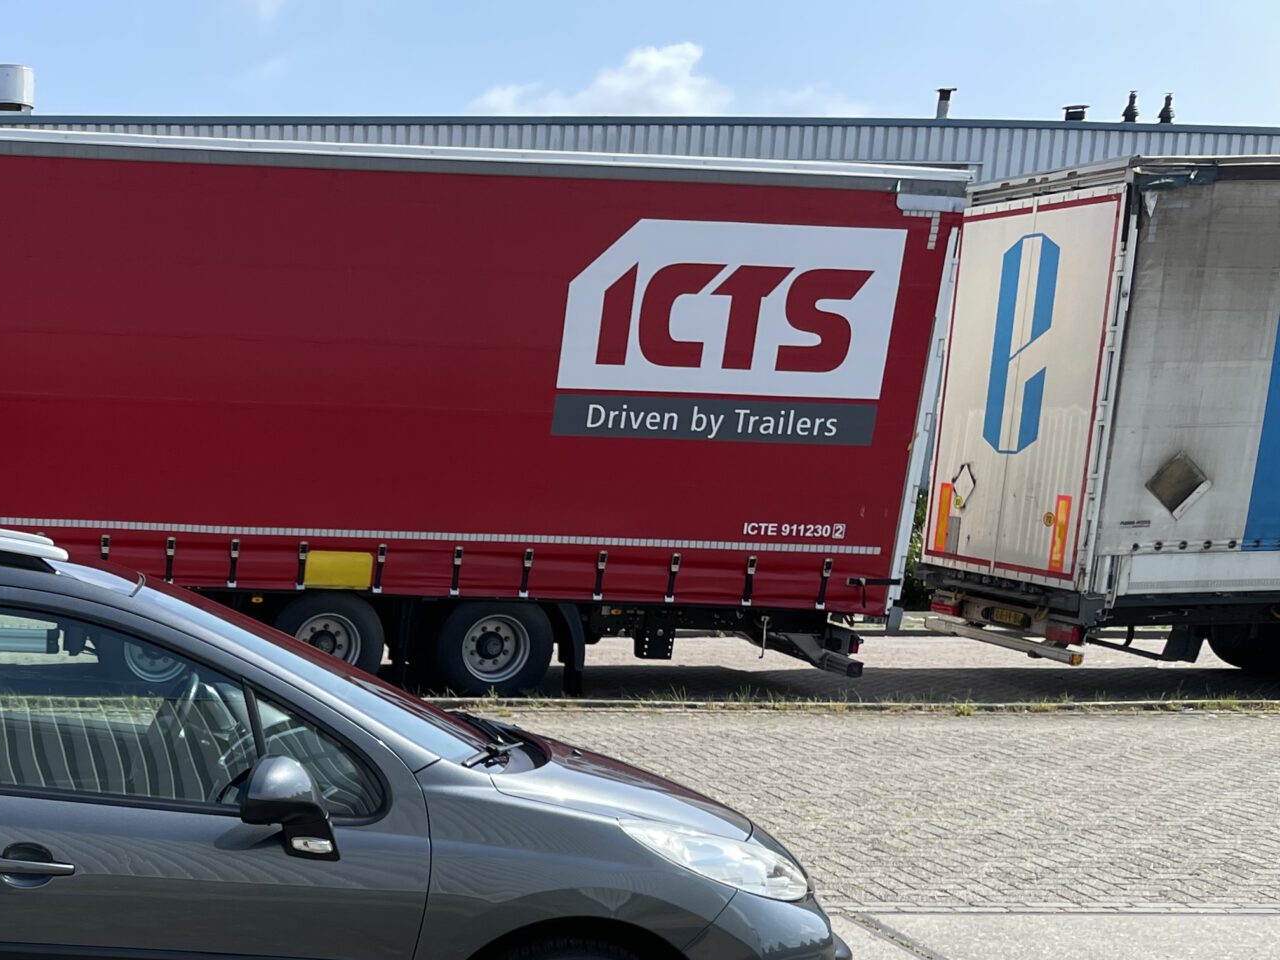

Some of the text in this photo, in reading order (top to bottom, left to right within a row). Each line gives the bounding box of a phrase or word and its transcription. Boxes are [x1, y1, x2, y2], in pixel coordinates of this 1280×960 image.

[595, 262, 875, 373] ICTS
[585, 404, 838, 439] Driven by Trailers
[743, 522, 778, 536] ICTE
[781, 523, 831, 537] 911230
